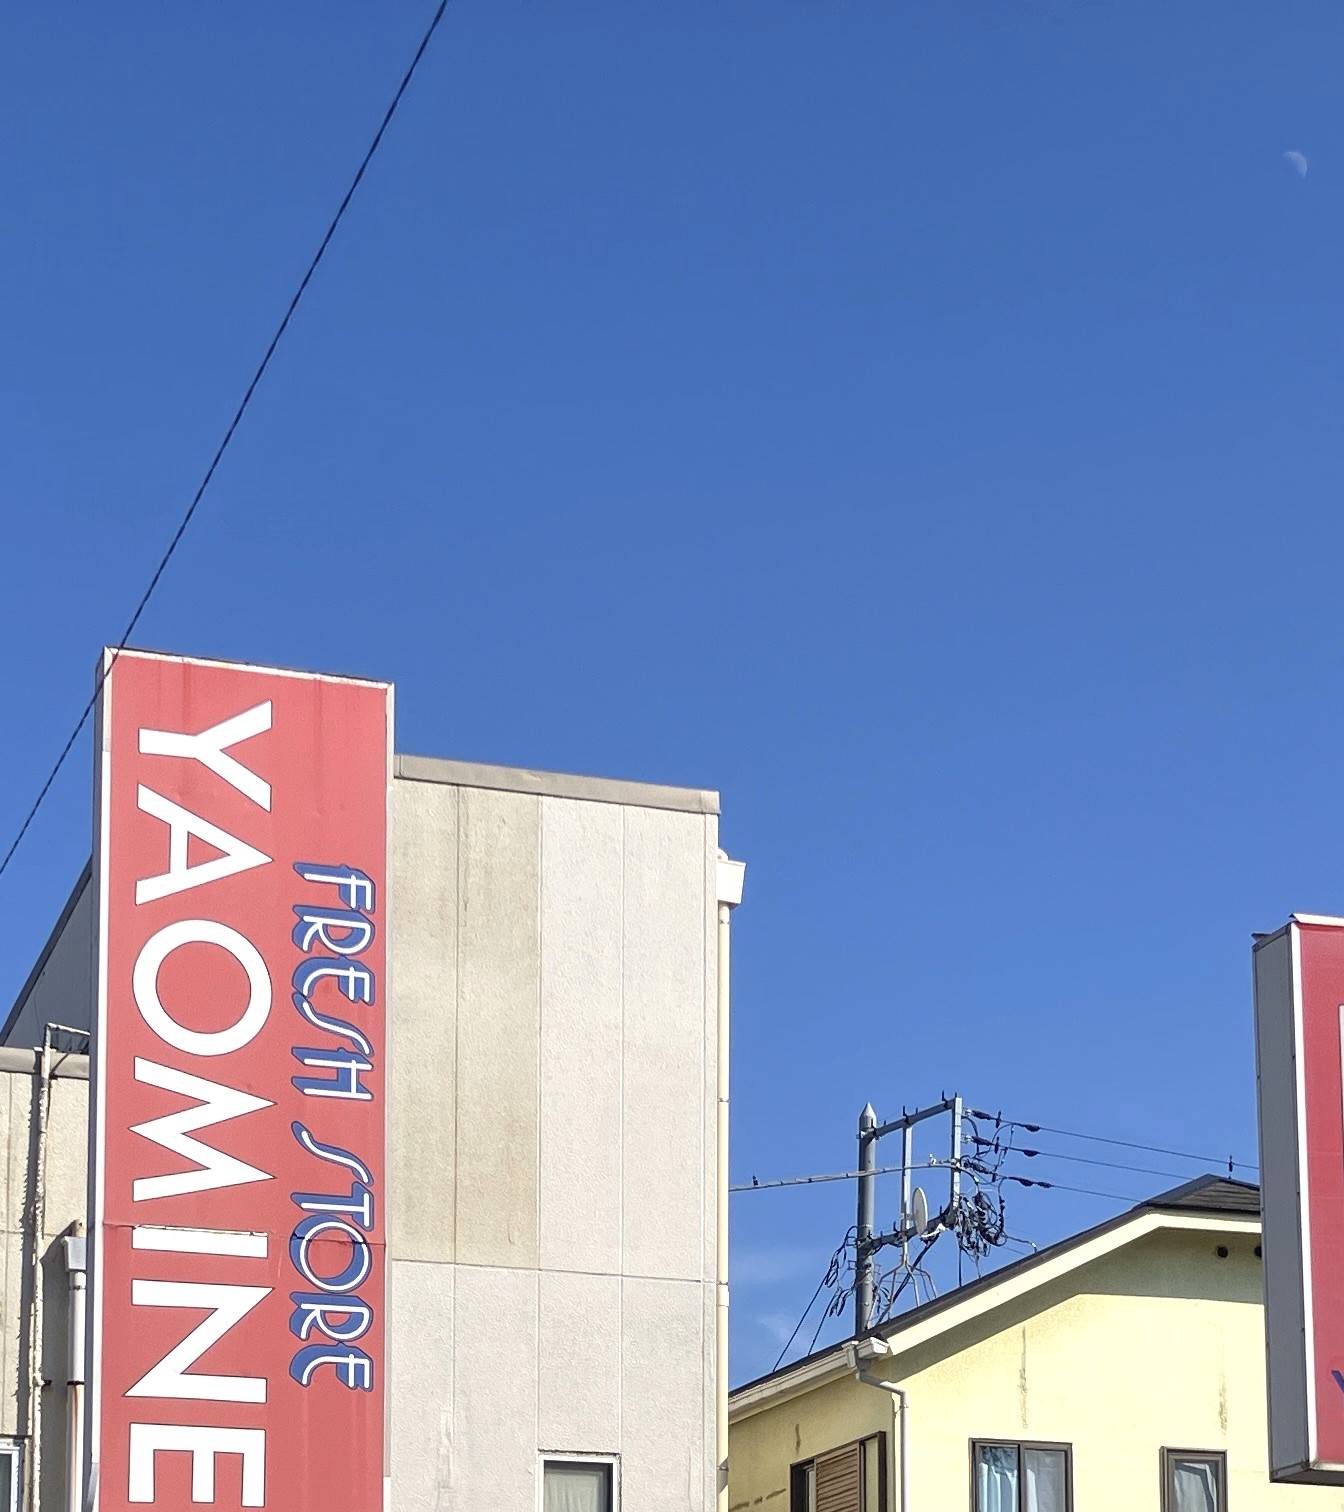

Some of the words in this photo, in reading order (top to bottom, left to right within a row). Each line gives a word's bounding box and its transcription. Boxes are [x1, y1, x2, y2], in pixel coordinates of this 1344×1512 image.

[124, 699, 277, 1508] YAOMINE
[291, 862, 375, 1101] FRESH
[289, 1121, 375, 1392] STORE
